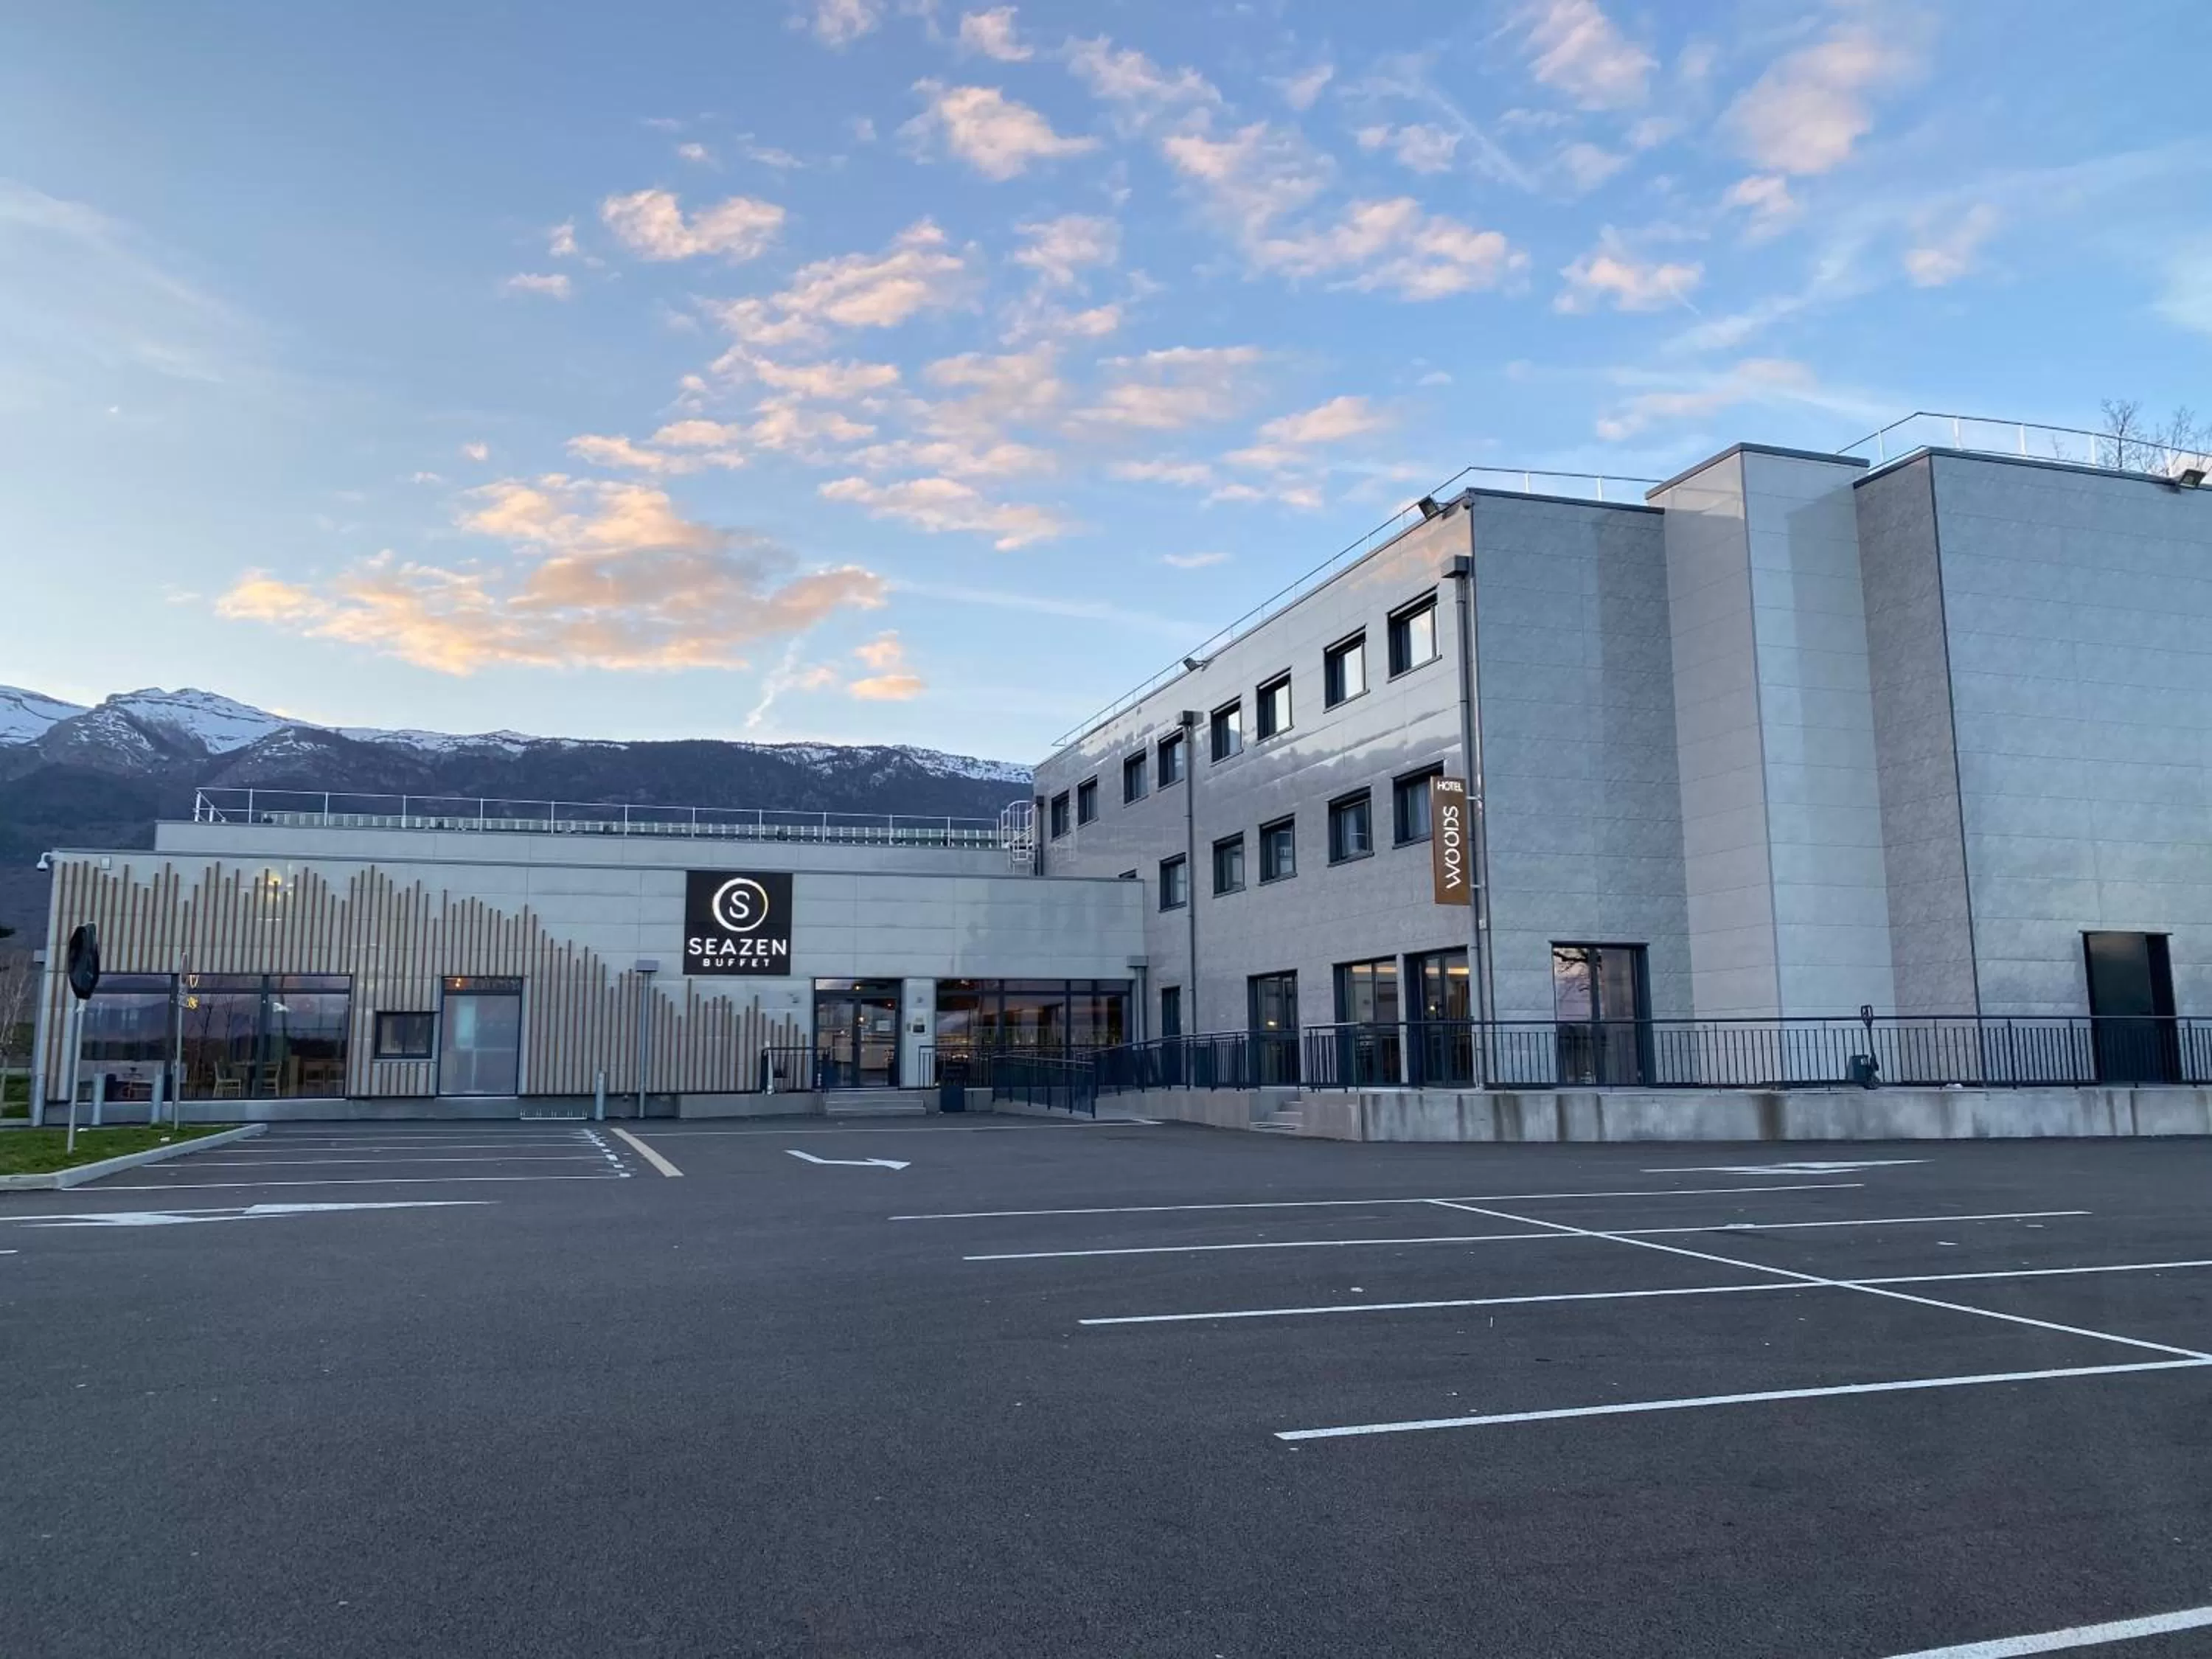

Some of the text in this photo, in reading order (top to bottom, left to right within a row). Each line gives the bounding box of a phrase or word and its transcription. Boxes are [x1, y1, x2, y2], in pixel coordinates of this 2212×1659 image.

[1437, 781, 1464, 792] HOTEL
[1443, 805, 1461, 888] WOODS
[729, 890, 750, 919] S
[688, 937, 787, 956] SEAZEN
[703, 958, 770, 967] BUFFET
